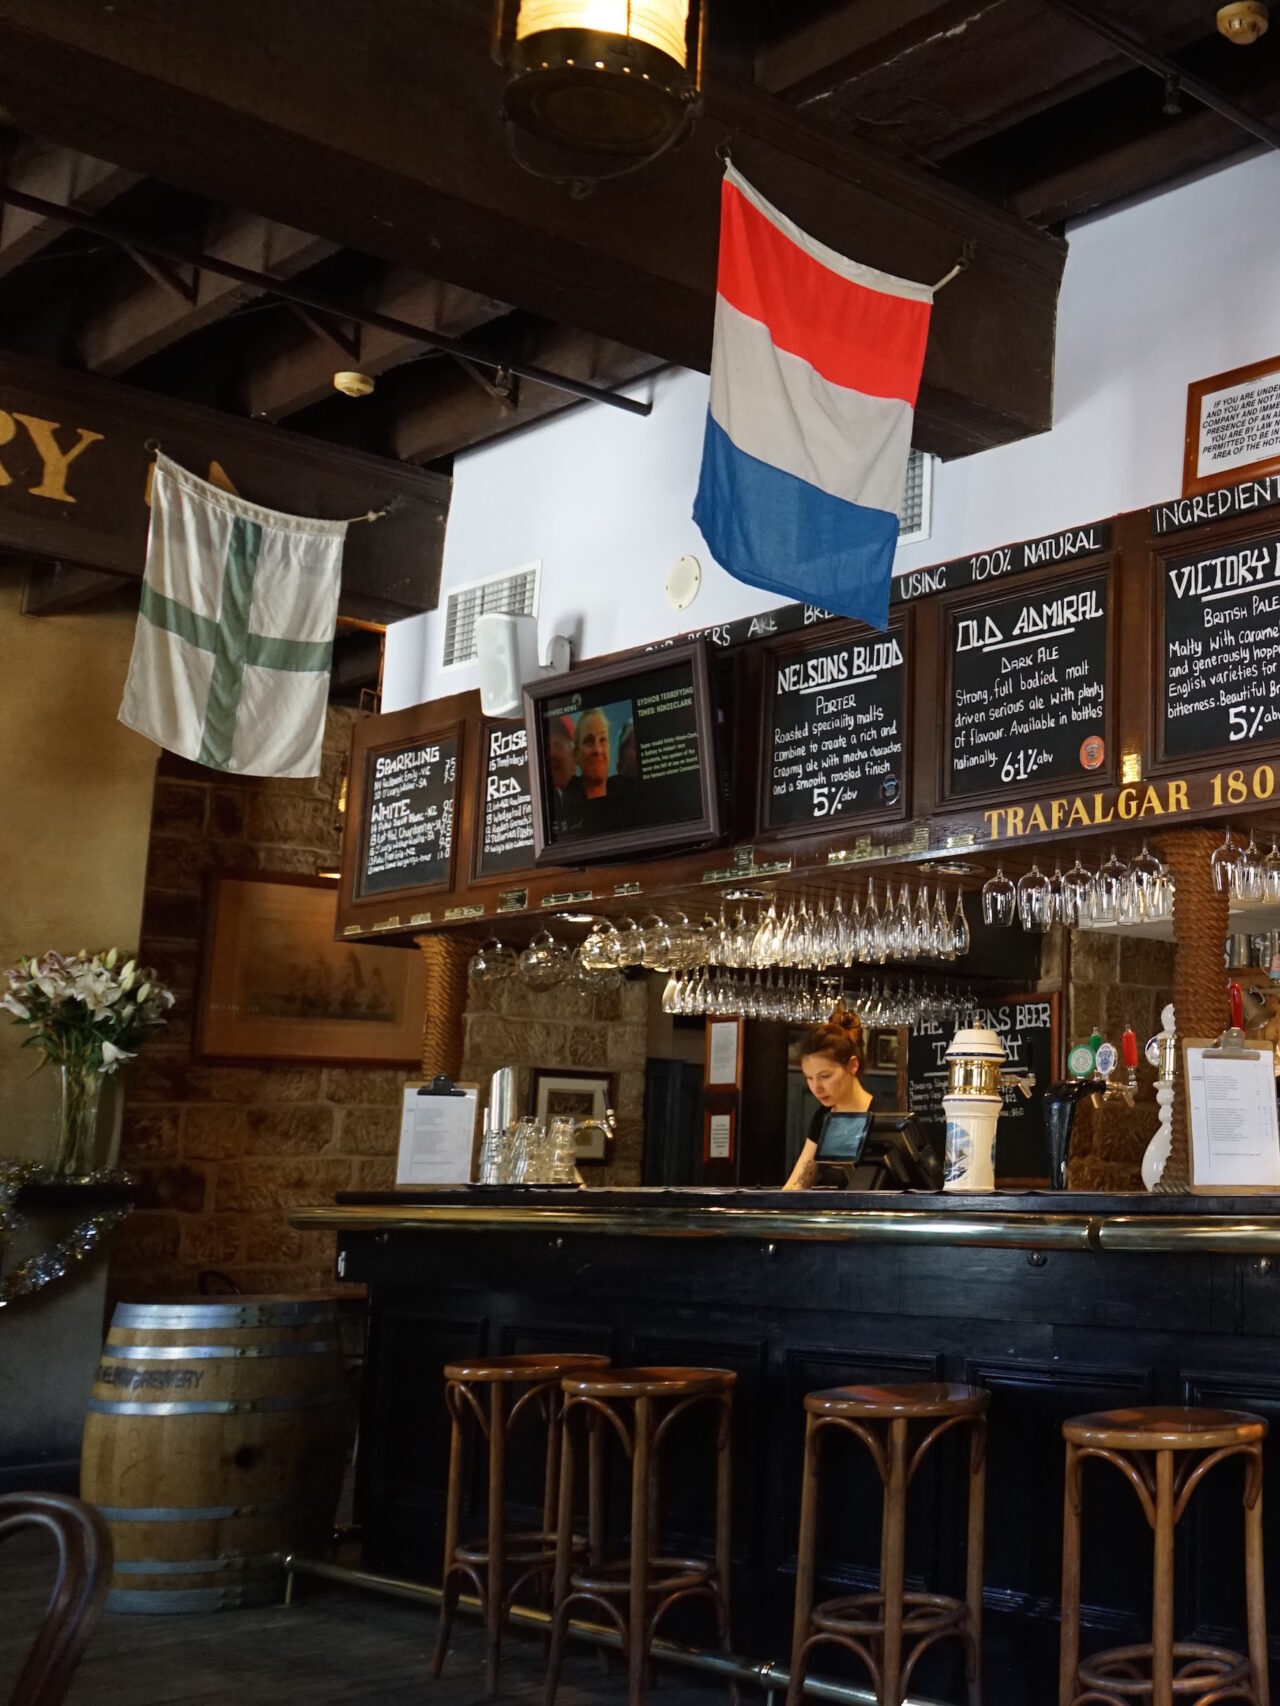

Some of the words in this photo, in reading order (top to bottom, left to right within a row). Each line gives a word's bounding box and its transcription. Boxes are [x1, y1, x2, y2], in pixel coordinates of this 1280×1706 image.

[1206, 408, 1223, 419] AND
[1224, 404, 1239, 415] YOU
[1240, 400, 1255, 410] ARE
[1257, 394, 1273, 405] NOT
[1214, 400, 1222, 408] IF
[1223, 396, 1239, 406] YOU
[1240, 391, 1255, 402] ARE
[1202, 413, 1240, 429] COMPANY
[1241, 407, 1258, 418] AND
[1206, 420, 1246, 436] PRESENCE
[1247, 415, 1257, 425] OF
[1260, 412, 1271, 422] AN
[1211, 432, 1227, 443] YOU
[1228, 428, 1243, 439] ARE
[1245, 425, 1255, 434] BY
[1256, 420, 1273, 431] LAW
[1203, 436, 1245, 454] PERMITTED
[1247, 433, 1258, 442] TO
[1259, 430, 1269, 439] BE
[1271, 427, 1280, 436] IN
[1211, 449, 1231, 461] AREA
[1232, 446, 1243, 455] OF
[1245, 441, 1261, 452] THE
[1023, 528, 1100, 568] NATURAL
[900, 567, 947, 599] USING
[970, 550, 1012, 581] 100%
[1169, 547, 1270, 599] VICTORY
[956, 616, 1003, 651] OLD
[1012, 590, 1104, 635] ADMIRAL
[1204, 607, 1248, 628] BRITISH
[1252, 595, 1280, 615] PALE
[1169, 638, 1202, 659] Malty
[1210, 627, 1235, 652] with
[777, 652, 849, 694] NELSONS
[853, 639, 903, 676] BLOOD
[1001, 655, 1033, 673] DARK
[1038, 646, 1059, 663] ALE
[816, 694, 856, 715] PORTER
[775, 721, 809, 744] Roasted
[812, 712, 854, 737] speciality
[857, 705, 883, 725] malts
[954, 731, 965, 748] of
[970, 726, 1007, 746] flavour.
[1010, 713, 1055, 737] Available
[1059, 709, 1068, 724] in
[1071, 703, 1103, 722] bottles
[1229, 704, 1264, 741] 5%
[376, 746, 439, 779] SPARKLING
[1037, 749, 1053, 765] abv
[487, 775, 521, 802] RED
[813, 786, 844, 817] 5%
[841, 788, 857, 801] abv
[371, 798, 410, 822] WHITE
[985, 780, 1191, 840] TRAFALGAR
[1015, 1003, 1051, 1030] BEER
